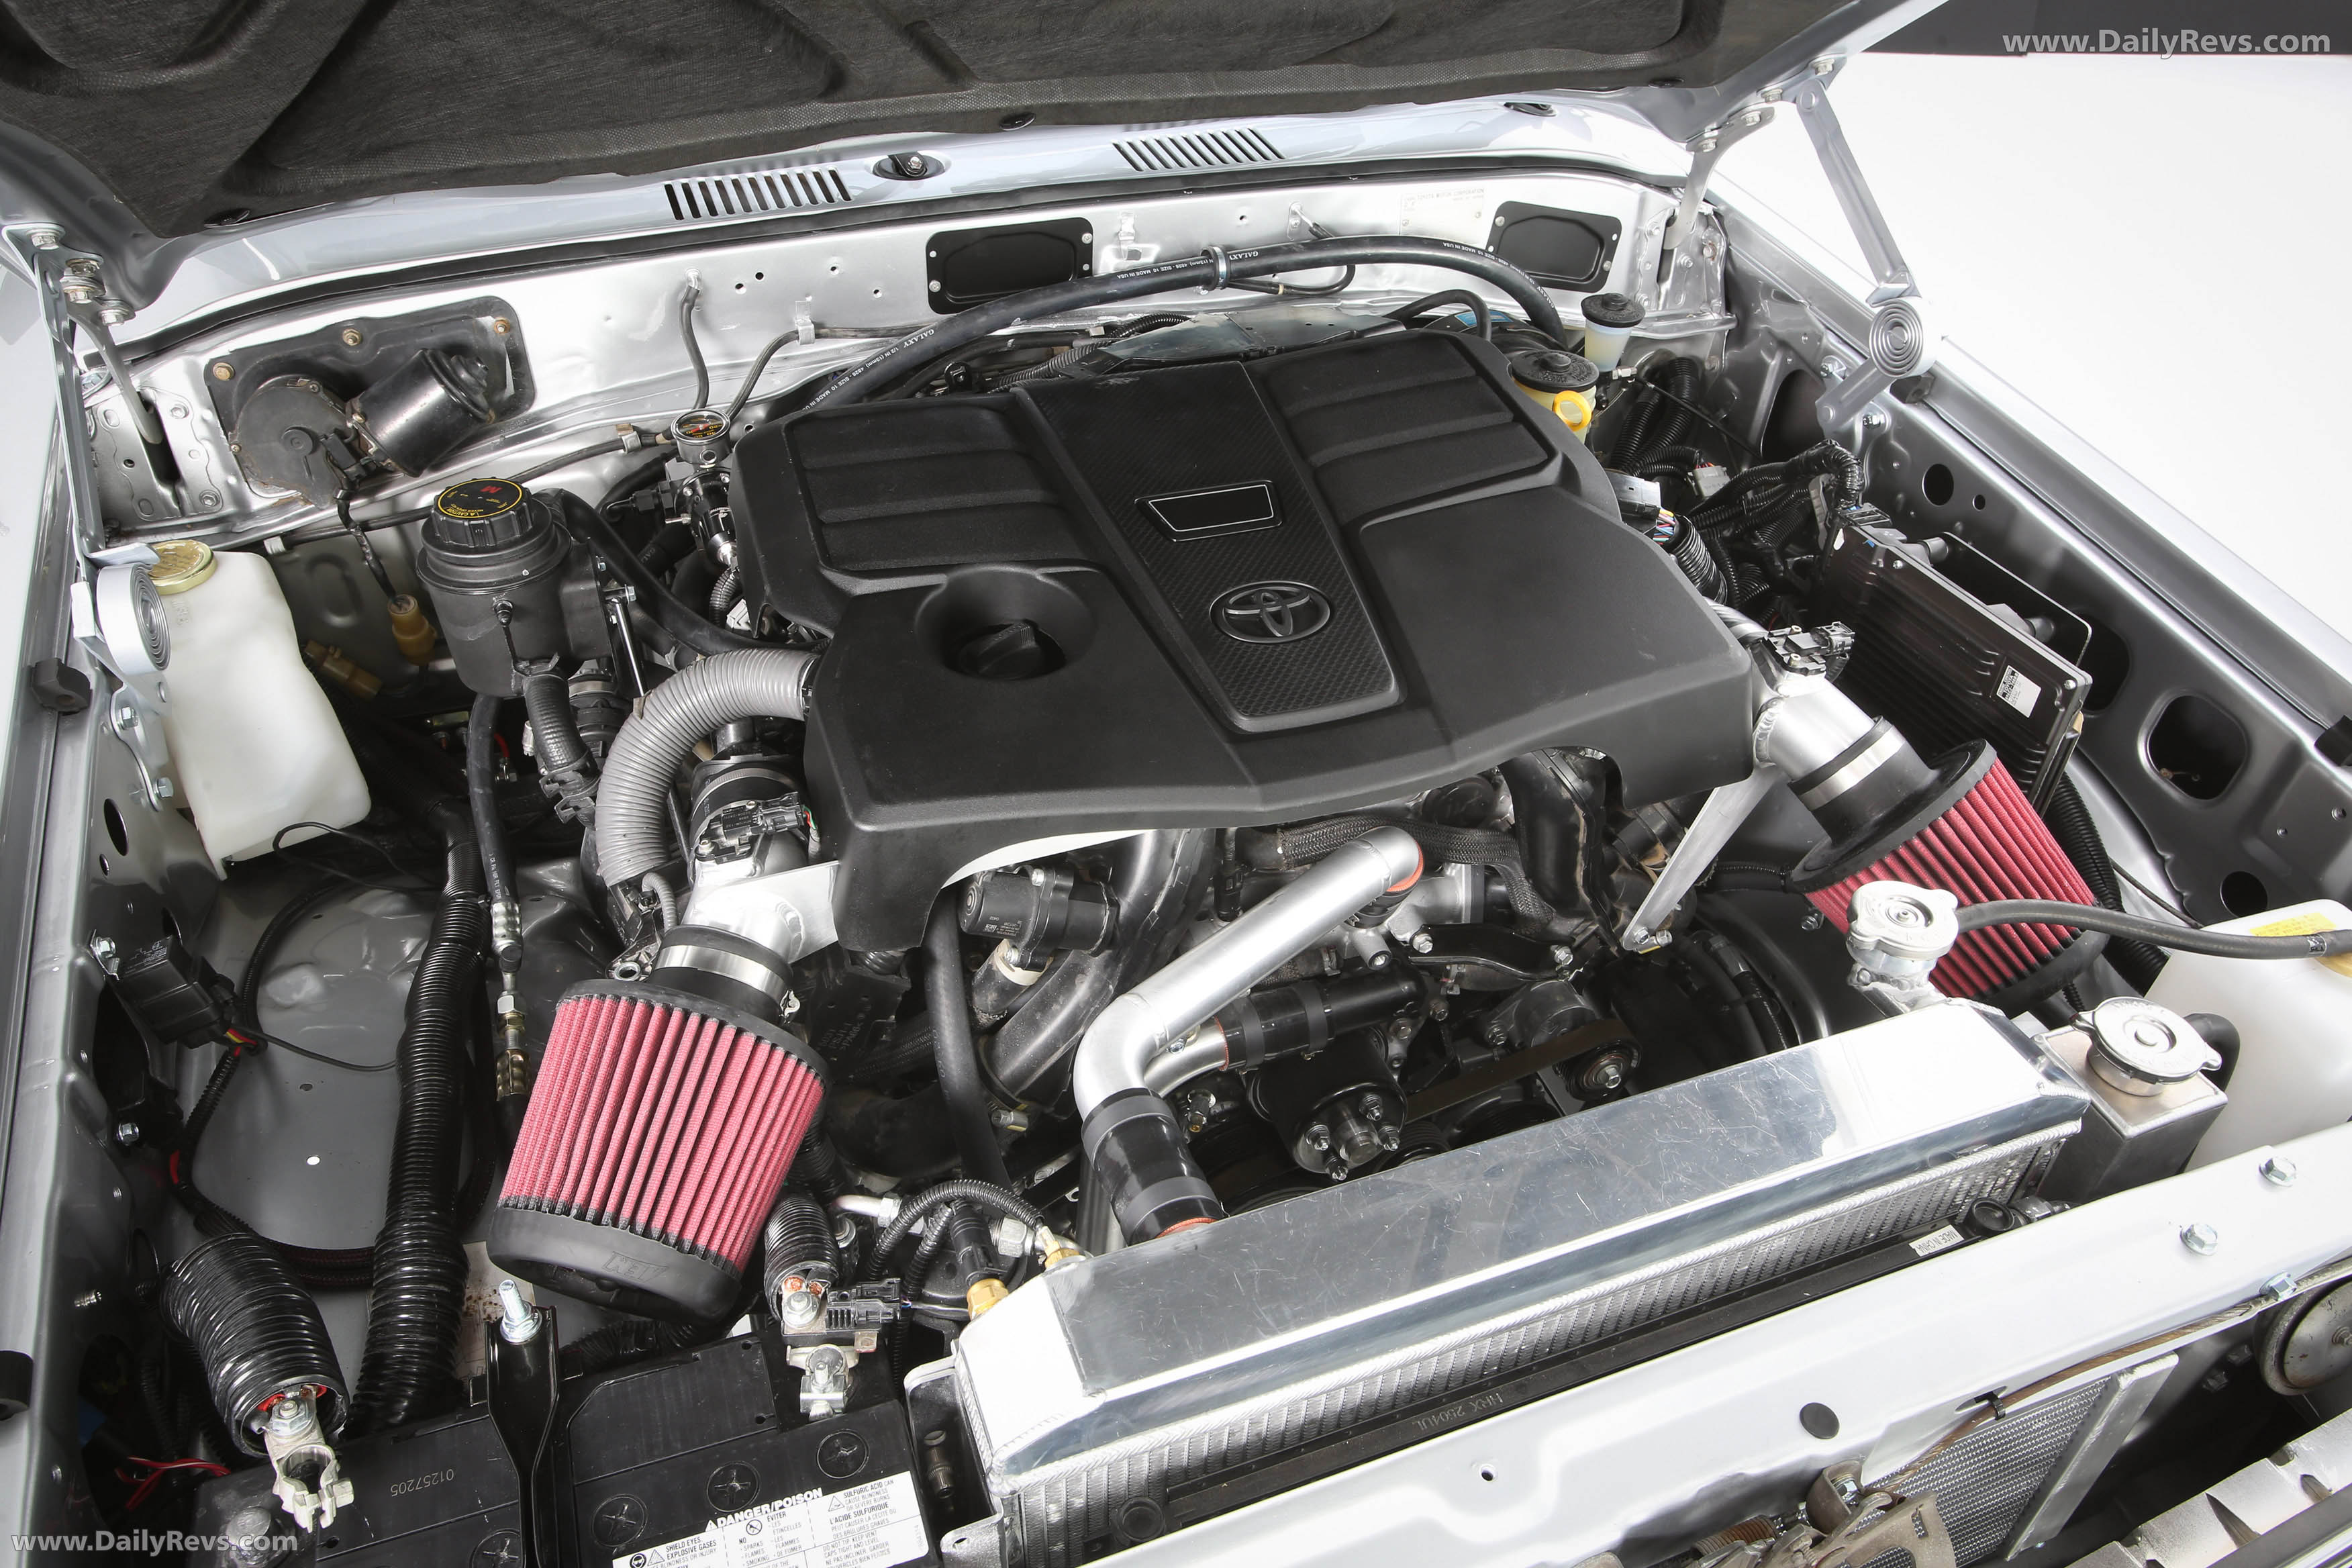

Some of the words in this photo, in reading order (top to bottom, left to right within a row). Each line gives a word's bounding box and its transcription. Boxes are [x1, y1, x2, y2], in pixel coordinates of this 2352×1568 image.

[1228, 250, 1259, 260] GALAXY
[1461, 245, 1476, 254] MADE
[903, 328, 935, 348] GALAXY
[865, 353, 885, 368] (13mm)
[837, 376, 850, 387] SIZE
[815, 389, 831, 403] MADE
[1932, 1237, 1942, 1246] IN
[1938, 1229, 1958, 1243] MADE
[1916, 1240, 1935, 1253] CHINA
[390, 1468, 454, 1497] 01257205
[843, 1485, 869, 1499] SULFURIC
[870, 1481, 883, 1491] ACID
[844, 1497, 861, 1506] CAUSE
[861, 1488, 888, 1500] BLINDNESS
[716, 1487, 824, 1528] DANGER/POISON
[829, 1513, 852, 1525] L'ACIDE
[853, 1502, 889, 1518] SULFURIQUE
[738, 1536, 747, 1545] NO
[865, 1530, 878, 1538] VENT
[665, 1540, 686, 1553] SHIELD
[667, 1545, 698, 1560] EXPLOSIVE
[698, 1540, 717, 1551] GASES
[698, 1547, 717, 1559] INJURY
[838, 1545, 852, 1554] TIGHT
[853, 1541, 864, 1549] AND
